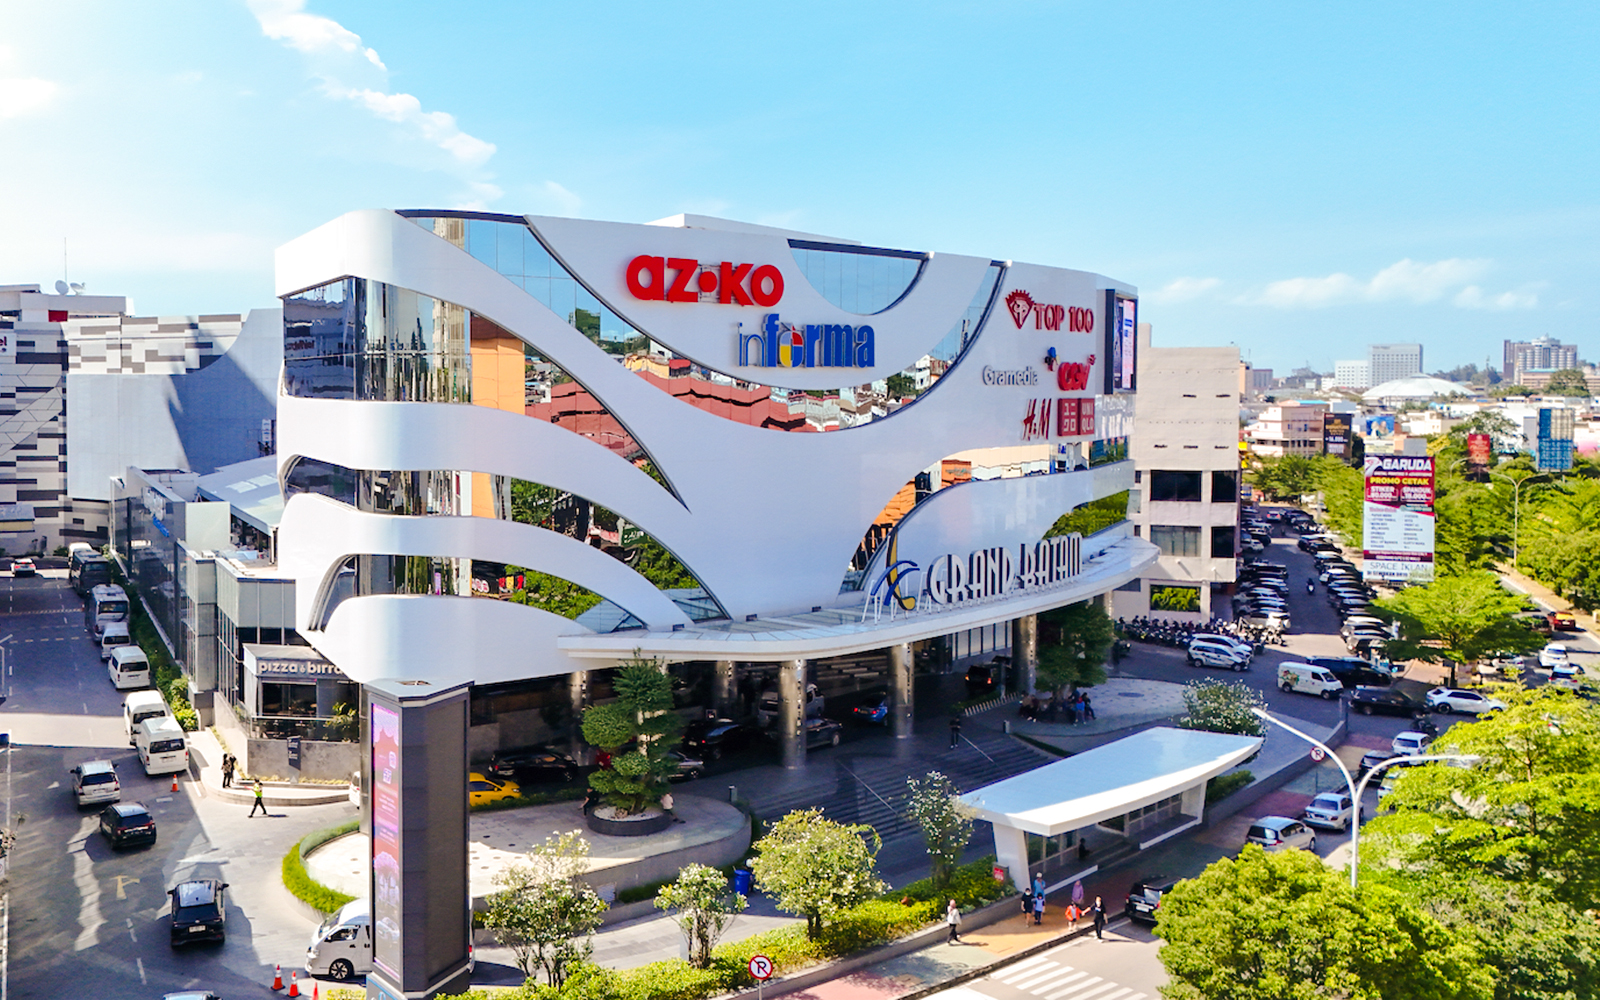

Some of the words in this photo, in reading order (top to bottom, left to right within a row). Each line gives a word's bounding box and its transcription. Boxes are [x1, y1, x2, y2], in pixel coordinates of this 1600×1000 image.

[1034, 303, 1065, 331] TOP
[1069, 306, 1094, 333] 100
[737, 313, 875, 368] informa
[982, 364, 1038, 386] Gramedia
[1057, 362, 1090, 391] CGV
[1081, 402, 1094, 415] UNI
[1081, 417, 1094, 432] QLO
[1382, 458, 1432, 471] GARUDA
[1370, 477, 1400, 485] PROMO
[1402, 477, 1429, 485] CETAK
[927, 547, 1015, 605] GRAND
[1016, 532, 1083, 588] BATAM
[1370, 562, 1397, 570] SPACE
[1401, 563, 1428, 572] IKLAN
[258, 662, 298, 674] pizza
[307, 661, 343, 674] birra
[757, 961, 767, 974] P
